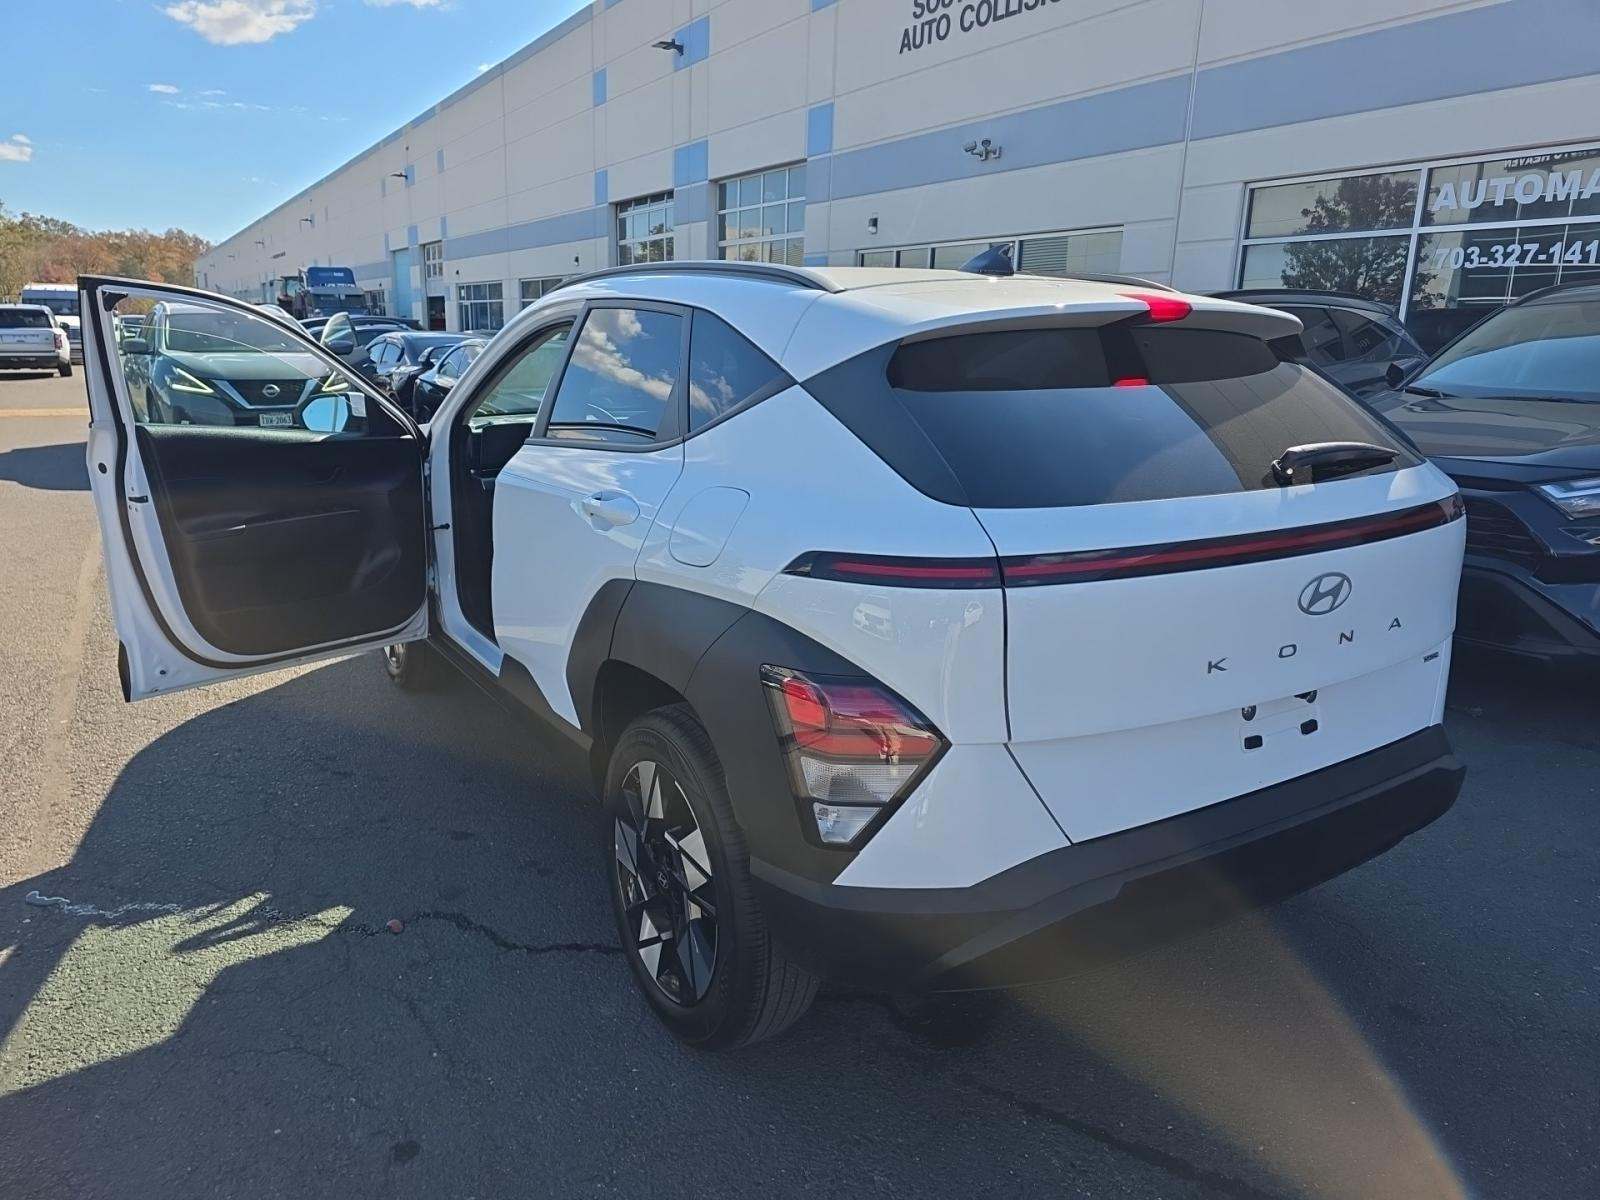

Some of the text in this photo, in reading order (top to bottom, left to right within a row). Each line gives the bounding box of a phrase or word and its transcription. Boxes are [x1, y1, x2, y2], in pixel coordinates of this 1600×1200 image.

[899, 13, 951, 54] AUTO
[1435, 239, 1599, 270] 703-327-141
[1207, 617, 1402, 674] KONA
